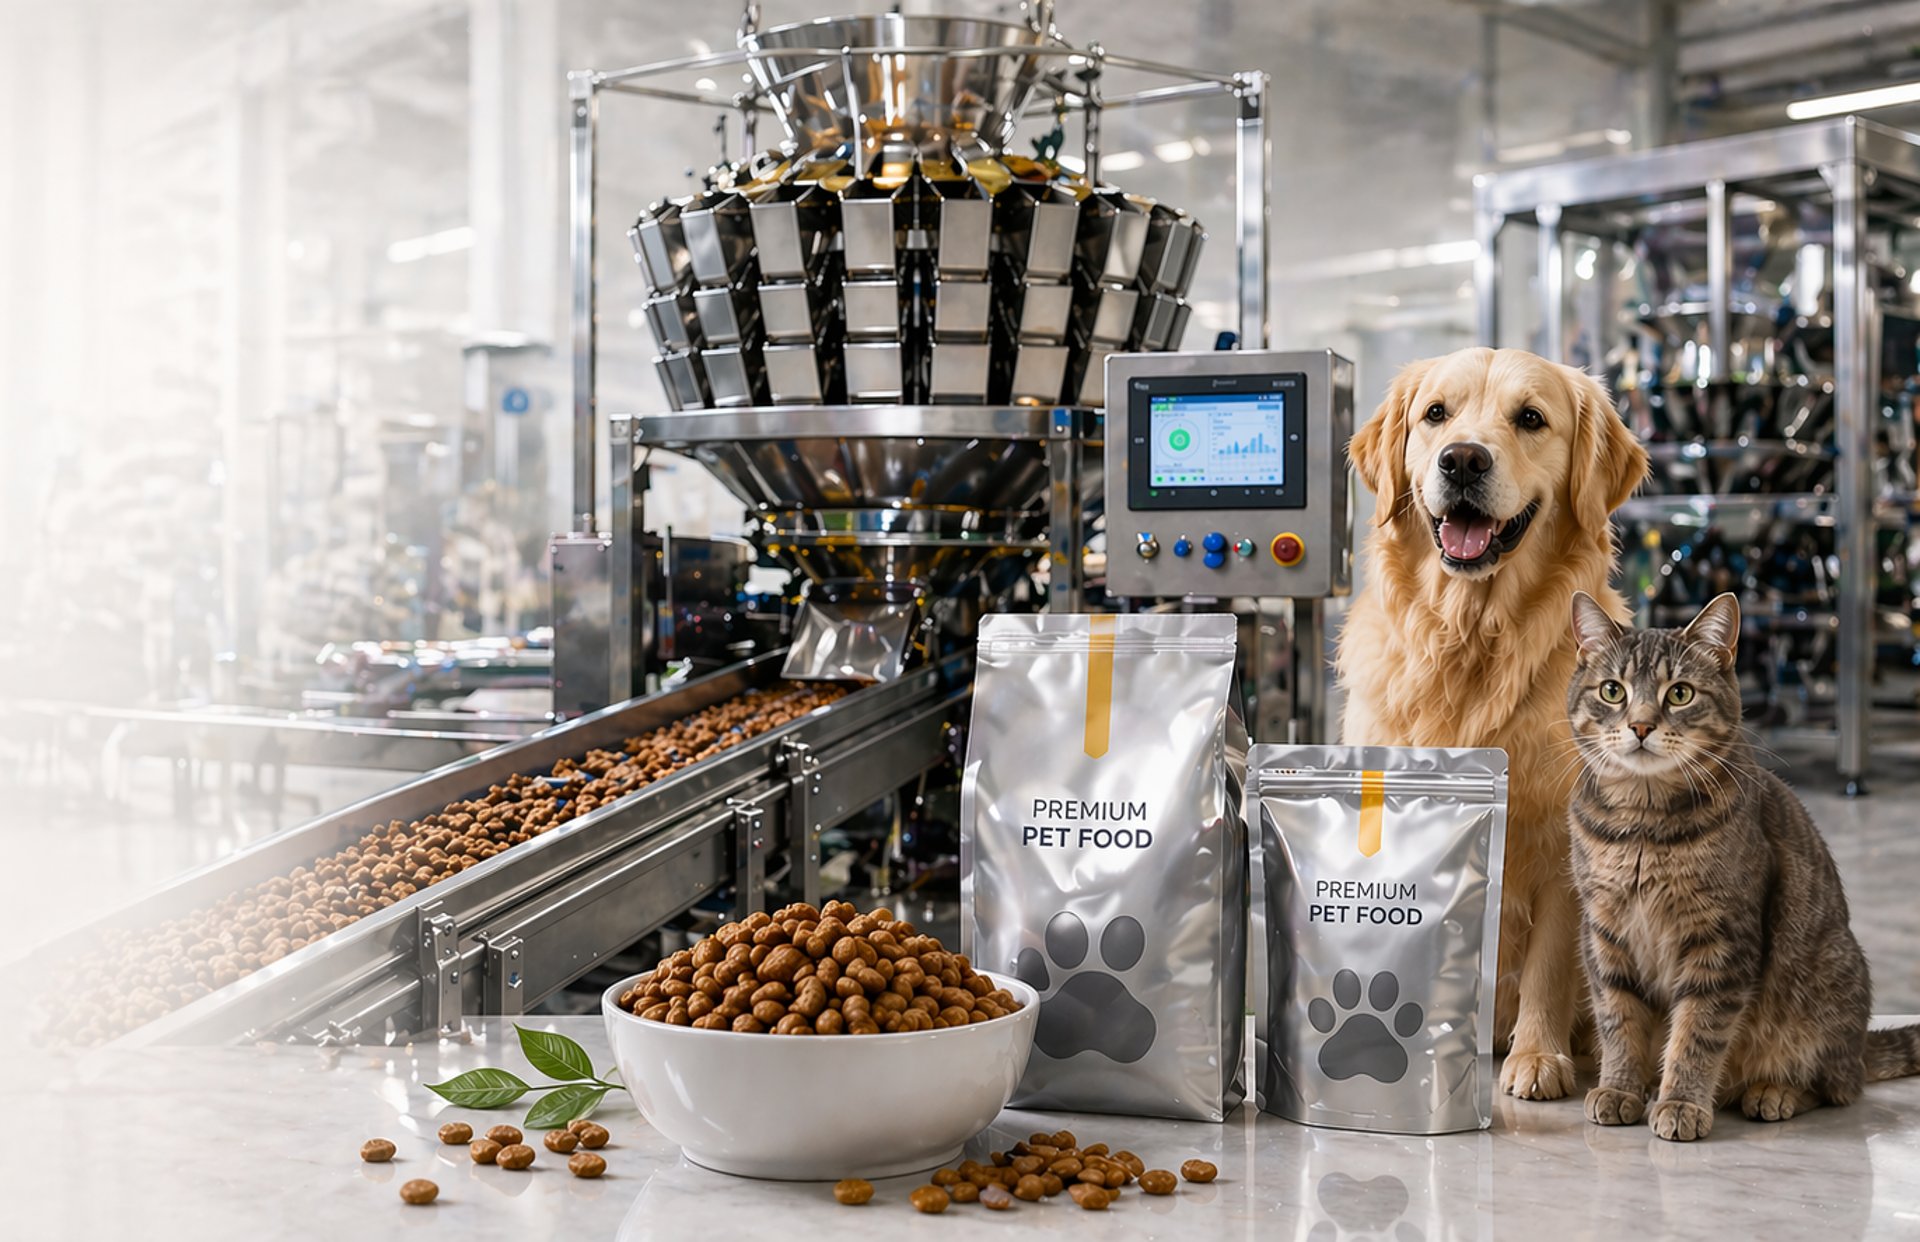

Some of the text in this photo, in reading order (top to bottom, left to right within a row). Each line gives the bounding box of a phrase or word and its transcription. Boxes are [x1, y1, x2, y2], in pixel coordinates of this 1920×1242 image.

[1033, 799, 1146, 821] PREMIUM
[1023, 826, 1153, 849] PET FOOD
[1316, 880, 1416, 900] PREMIUM
[1310, 905, 1422, 925] PET FOOD
